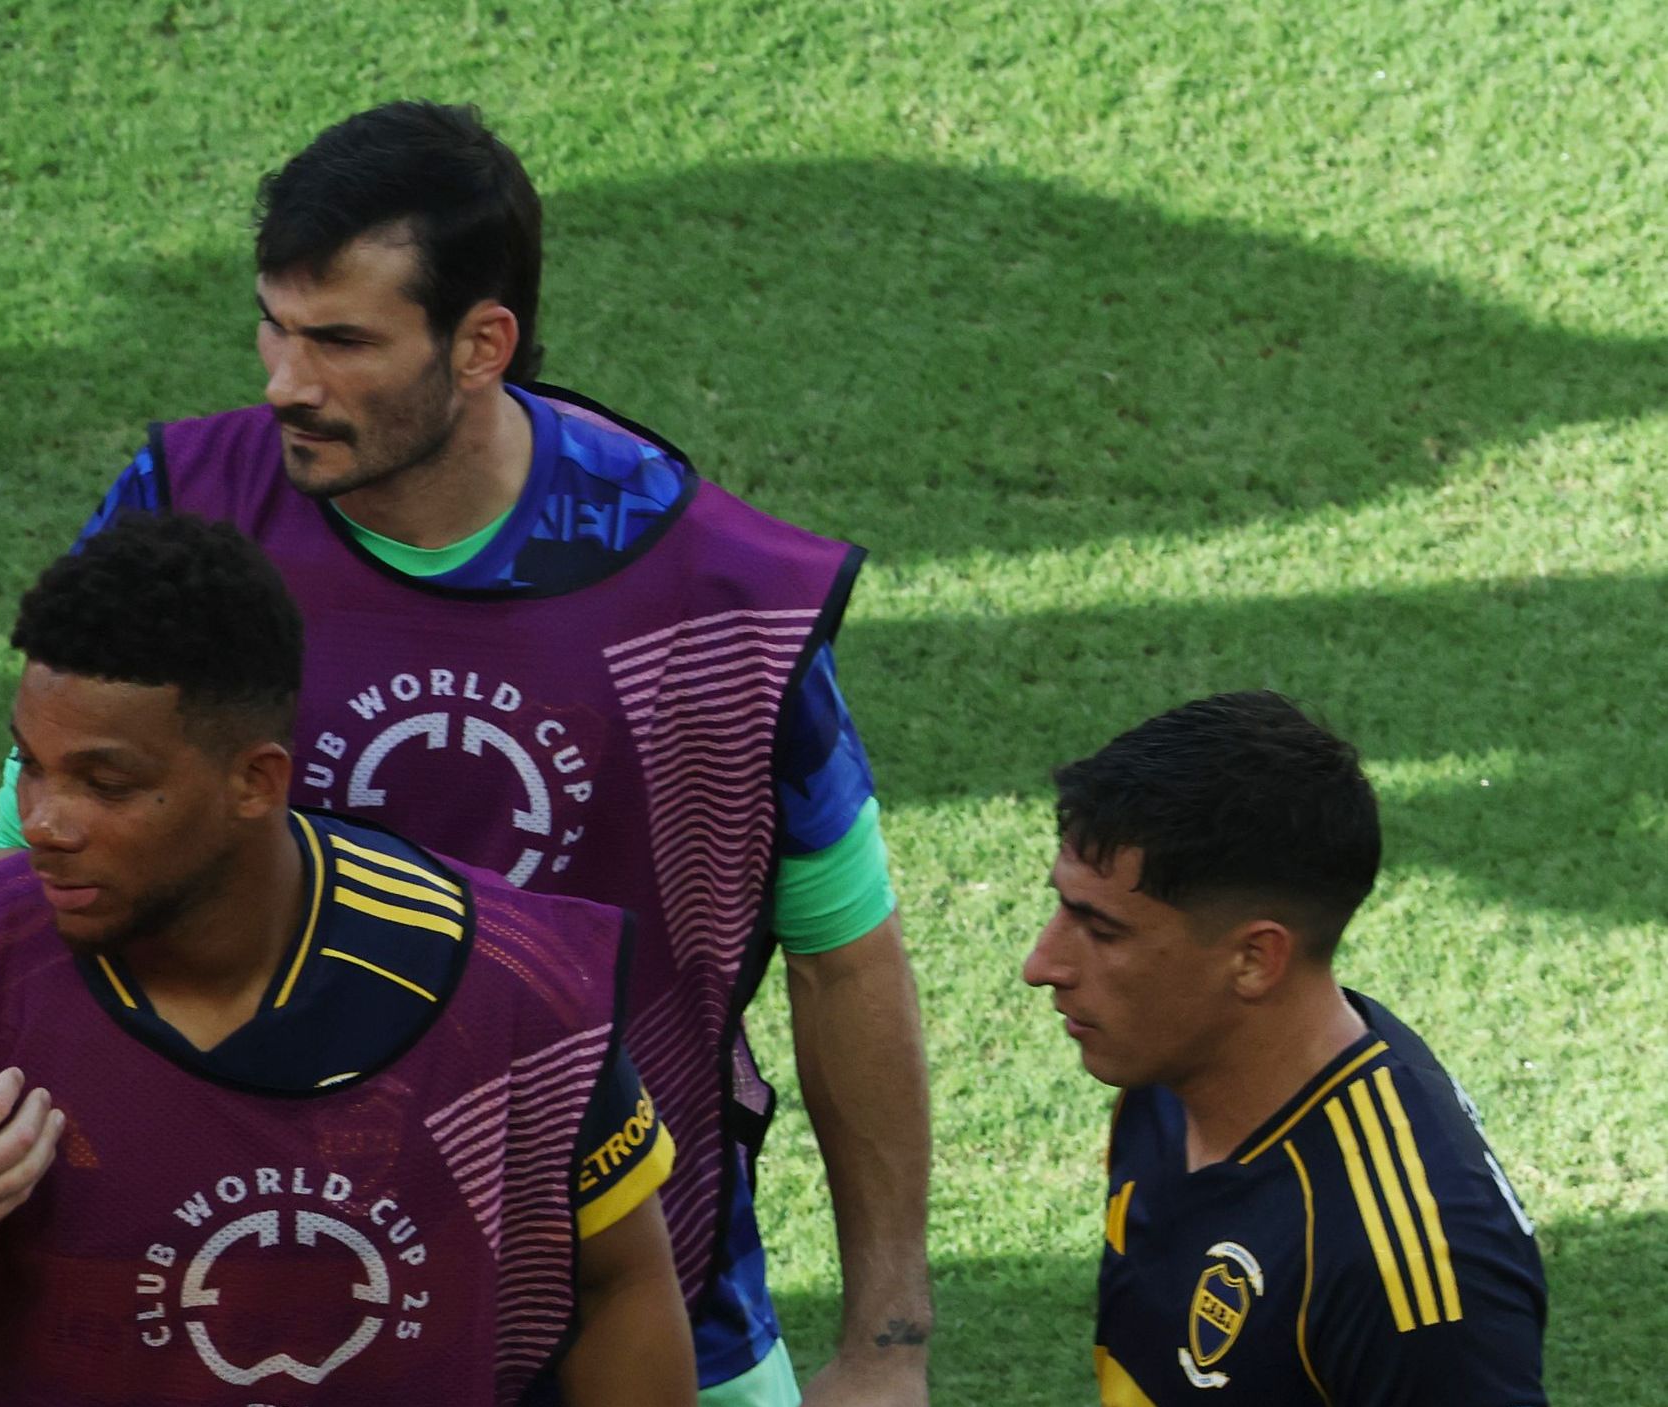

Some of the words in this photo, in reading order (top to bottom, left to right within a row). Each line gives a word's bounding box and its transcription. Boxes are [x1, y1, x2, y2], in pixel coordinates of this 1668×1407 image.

[347, 668, 522, 720] WORLD
[534, 719, 593, 803] CUP
[173, 1167, 353, 1227] WORLD
[369, 1196, 427, 1266] CUP
[136, 1243, 177, 1347] CLUB
[396, 1290, 430, 1339] 25
